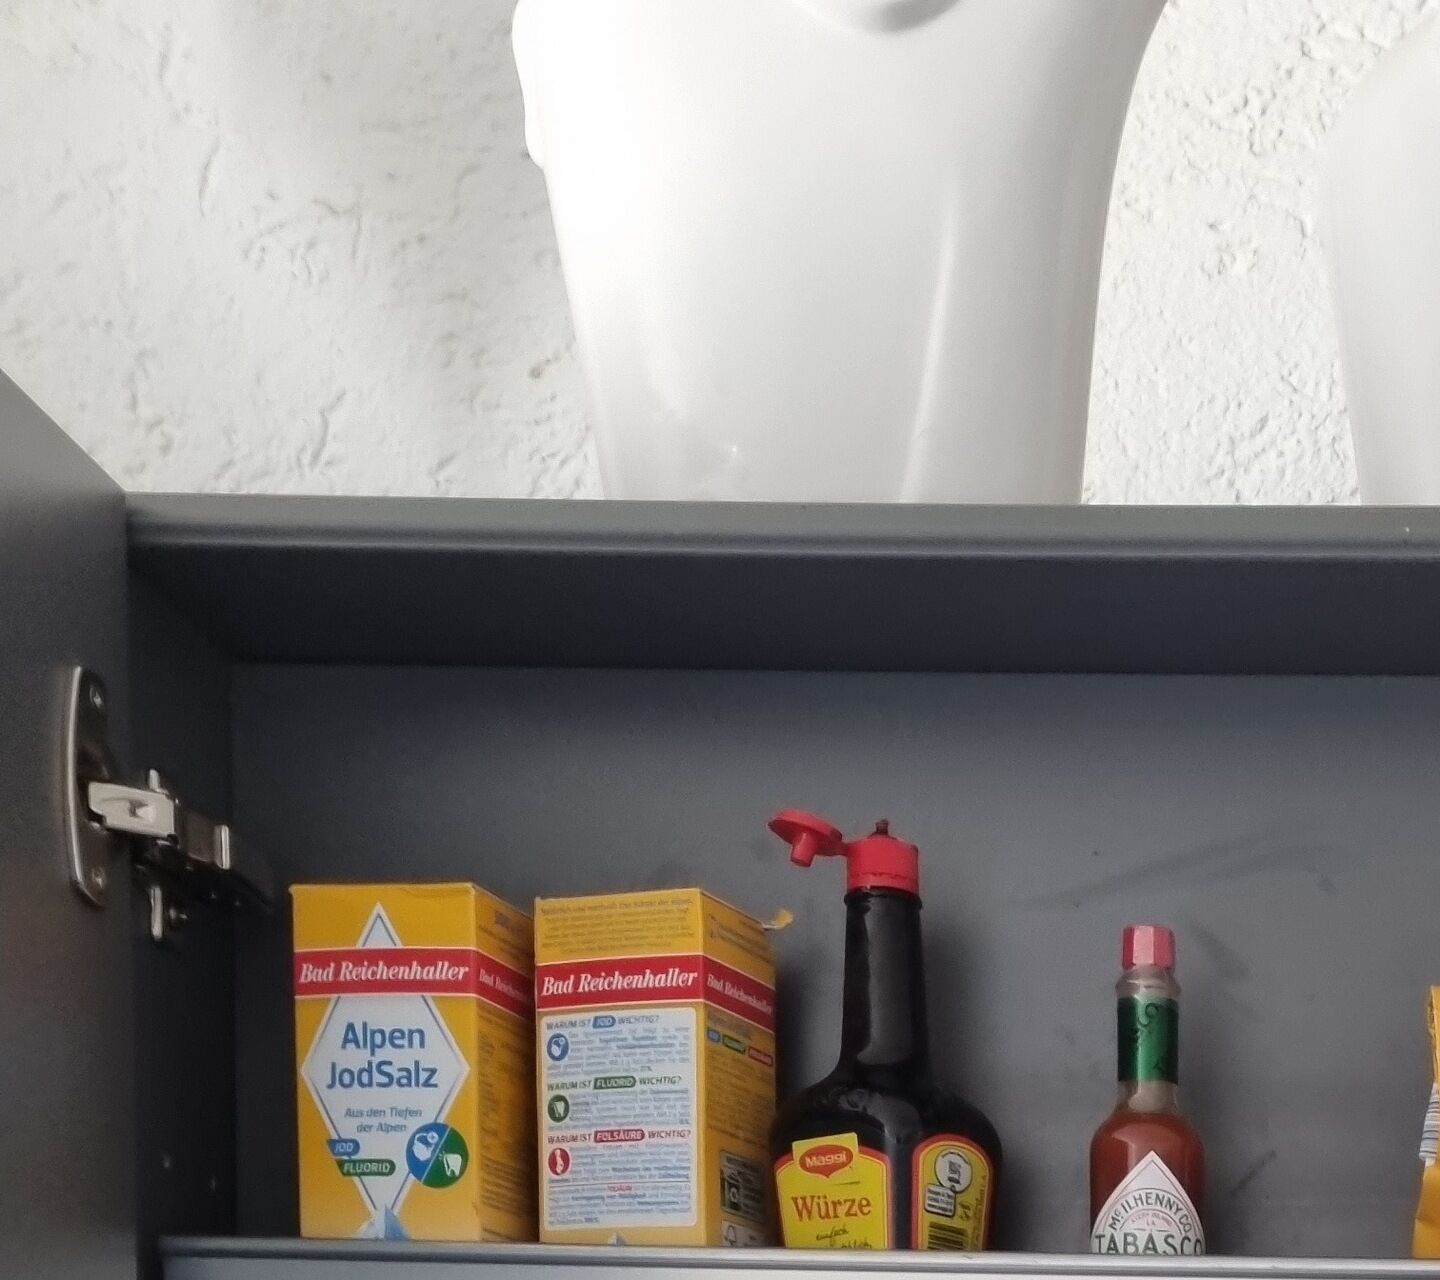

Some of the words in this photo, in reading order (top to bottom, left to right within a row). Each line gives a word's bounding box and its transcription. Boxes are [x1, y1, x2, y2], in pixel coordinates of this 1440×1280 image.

[300, 963, 334, 984] Bad
[340, 961, 469, 982] Reichenhaller
[541, 975, 574, 997] Bad
[577, 968, 699, 993] Reichenhaller
[341, 1021, 425, 1057] Alpen
[326, 1060, 438, 1089] JodSalz
[344, 1108, 364, 1118] Aus
[366, 1107, 386, 1118] den
[389, 1106, 422, 1120] Tiefen
[356, 1122, 374, 1133] der
[376, 1122, 407, 1136] Alpen
[335, 1143, 354, 1152] JOD
[343, 1162, 390, 1174] FLUORID
[805, 1152, 847, 1168] Maggi
[791, 1195, 872, 1222] Würze
